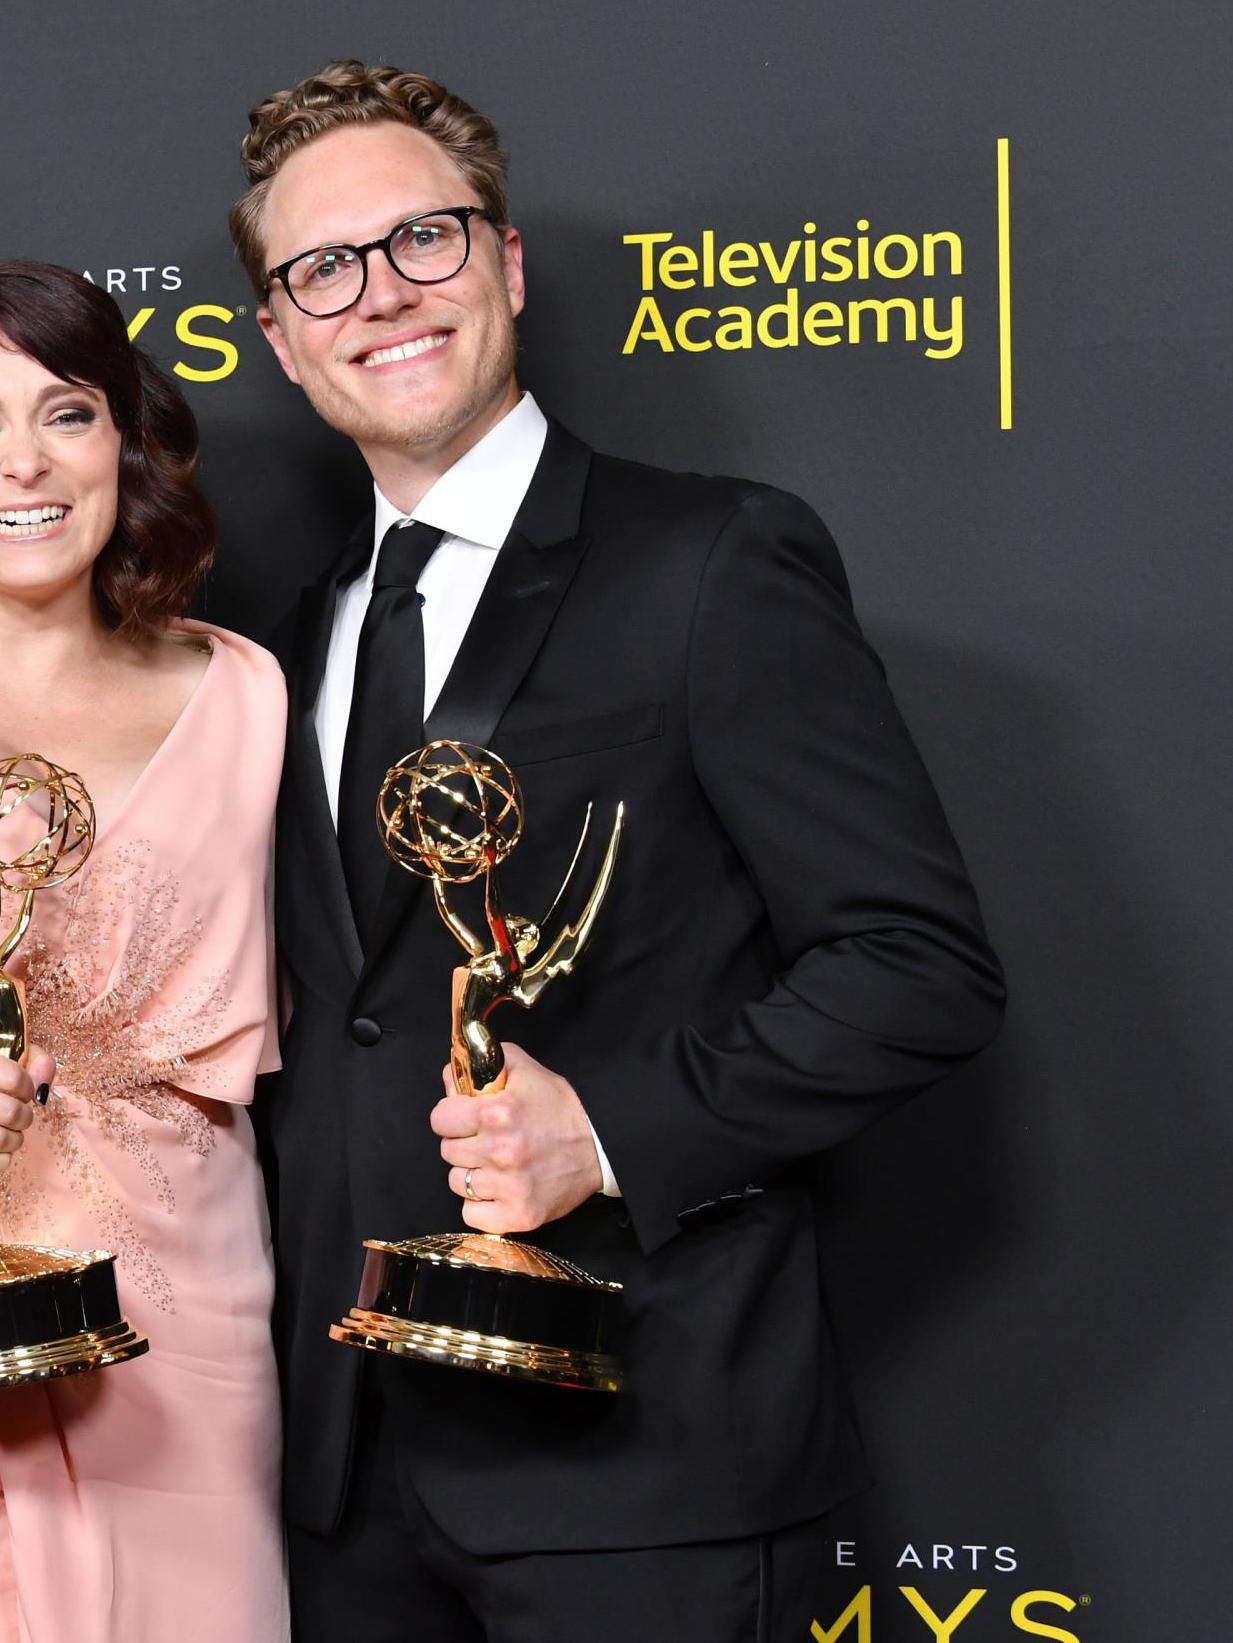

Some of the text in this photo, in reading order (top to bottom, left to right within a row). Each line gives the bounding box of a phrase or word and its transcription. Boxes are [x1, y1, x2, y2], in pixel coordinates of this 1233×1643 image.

[82, 265, 182, 293] RTS
[622, 218, 963, 291] Television
[621, 287, 964, 360] Academy
[895, 1543, 1018, 1573] ARTS
